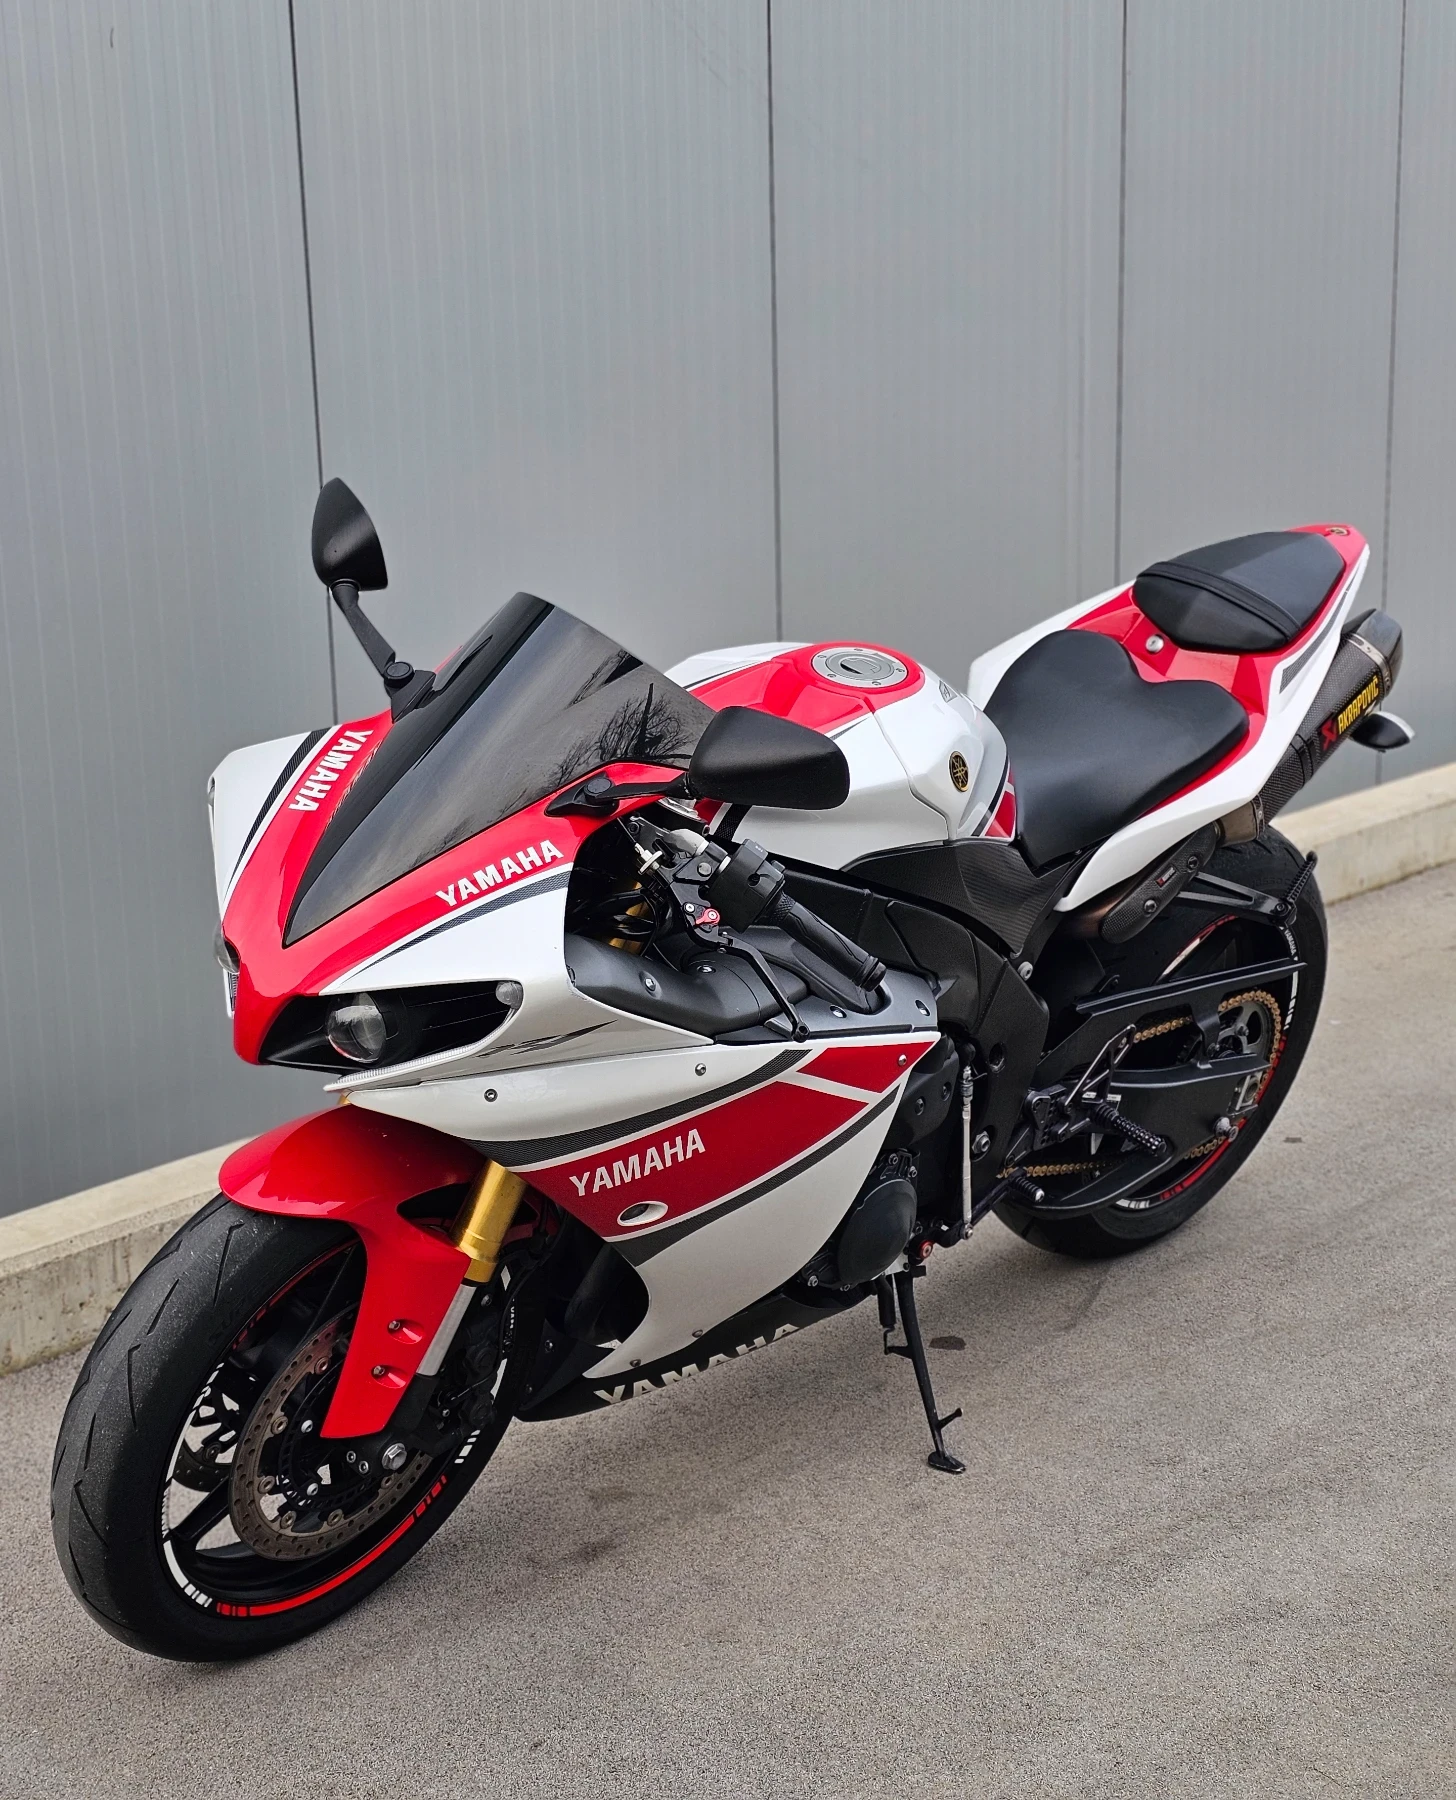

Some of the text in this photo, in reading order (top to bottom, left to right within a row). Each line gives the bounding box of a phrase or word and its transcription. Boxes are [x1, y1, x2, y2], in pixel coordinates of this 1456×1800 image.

[288, 730, 374, 811] YAMAHA
[436, 840, 564, 907] YAMAHA
[1284, 929, 1297, 956] YAMAHA
[569, 1128, 706, 1197] YAMAHA
